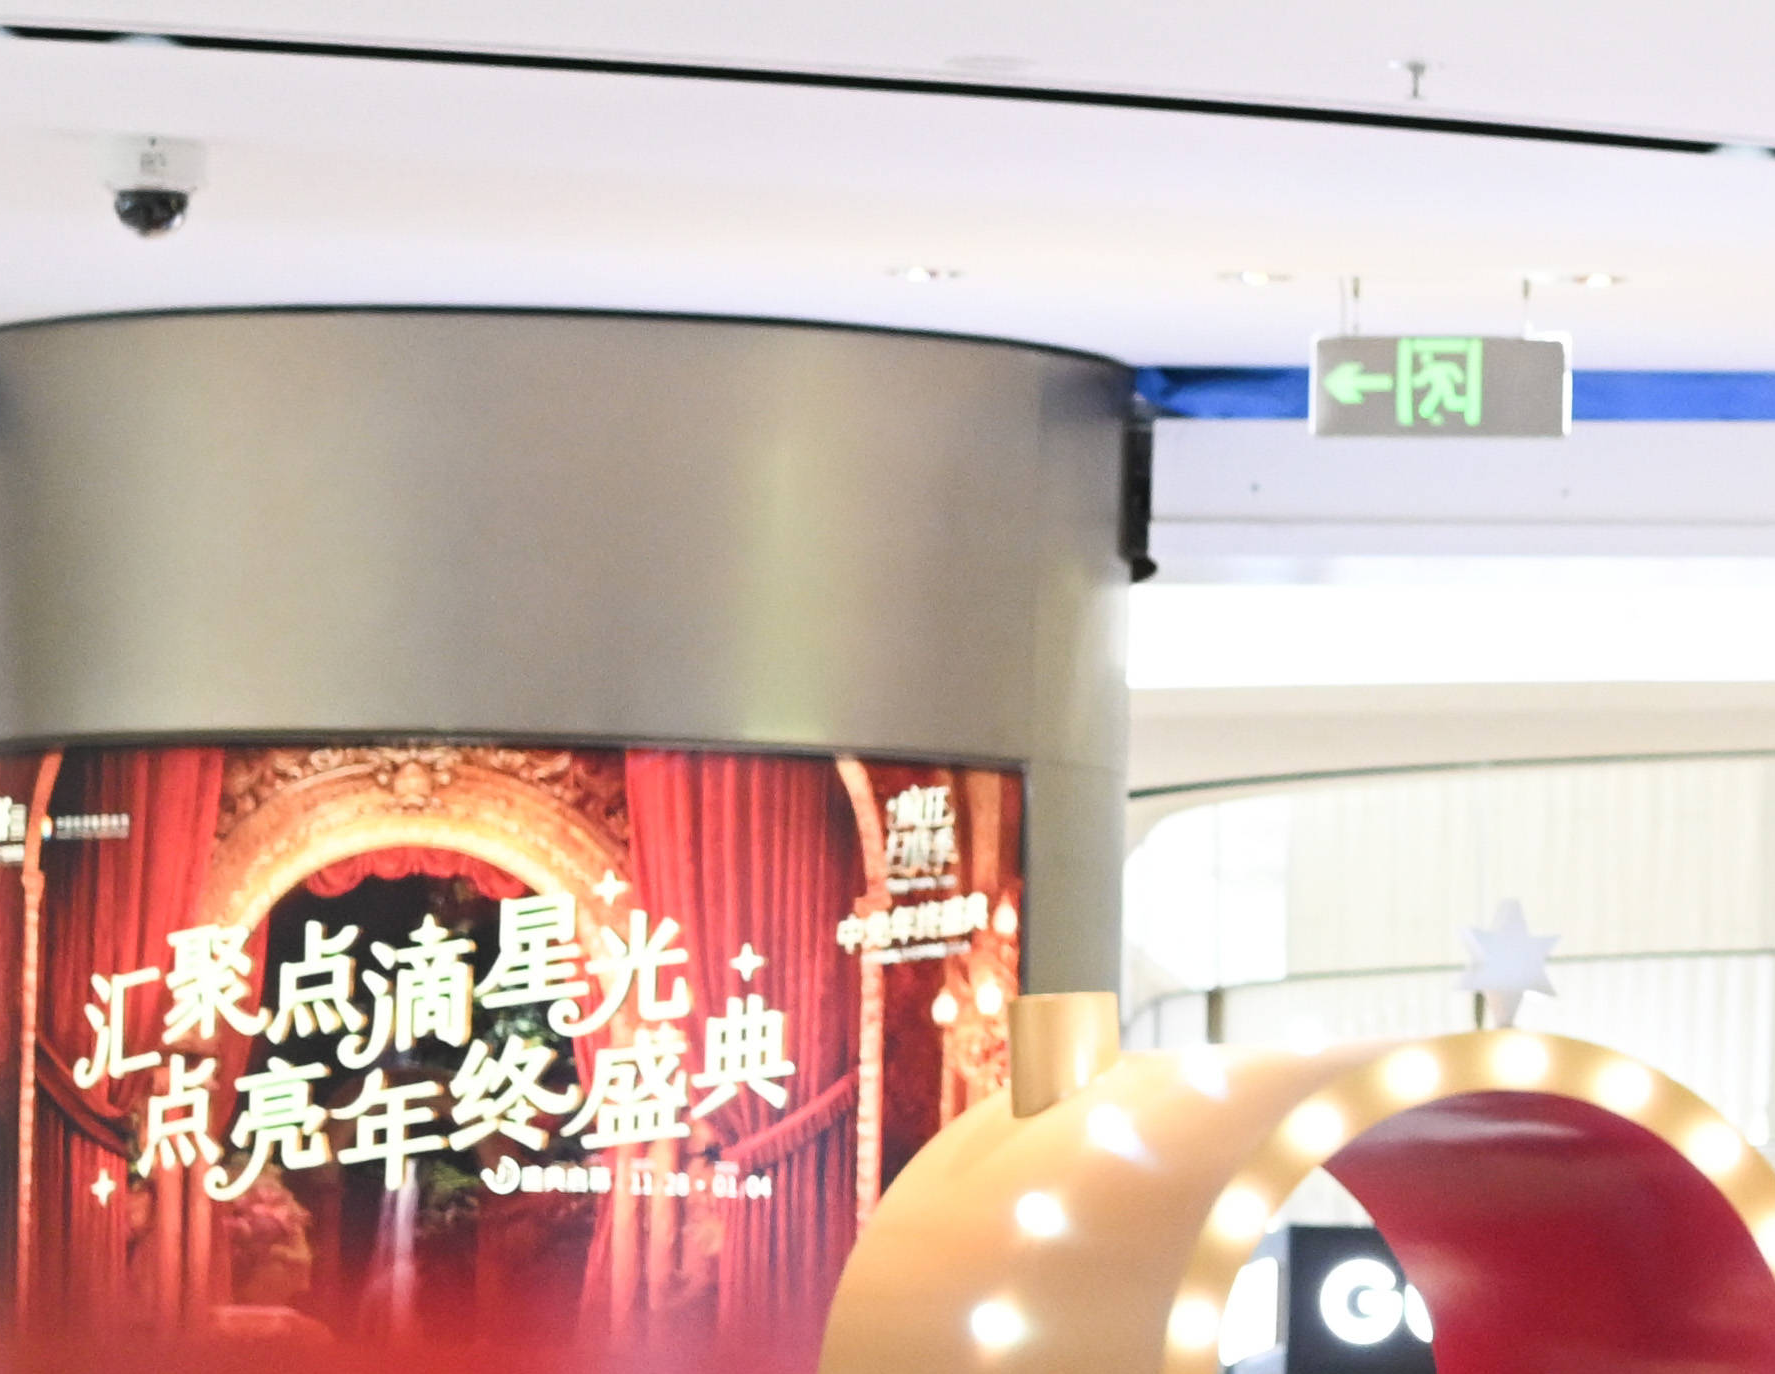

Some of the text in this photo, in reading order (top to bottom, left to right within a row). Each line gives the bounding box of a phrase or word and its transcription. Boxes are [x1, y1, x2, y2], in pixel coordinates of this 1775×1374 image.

[73, 893, 691, 1090] 汇聚点滴星光
[136, 993, 796, 1201] 点亮年终盛典
